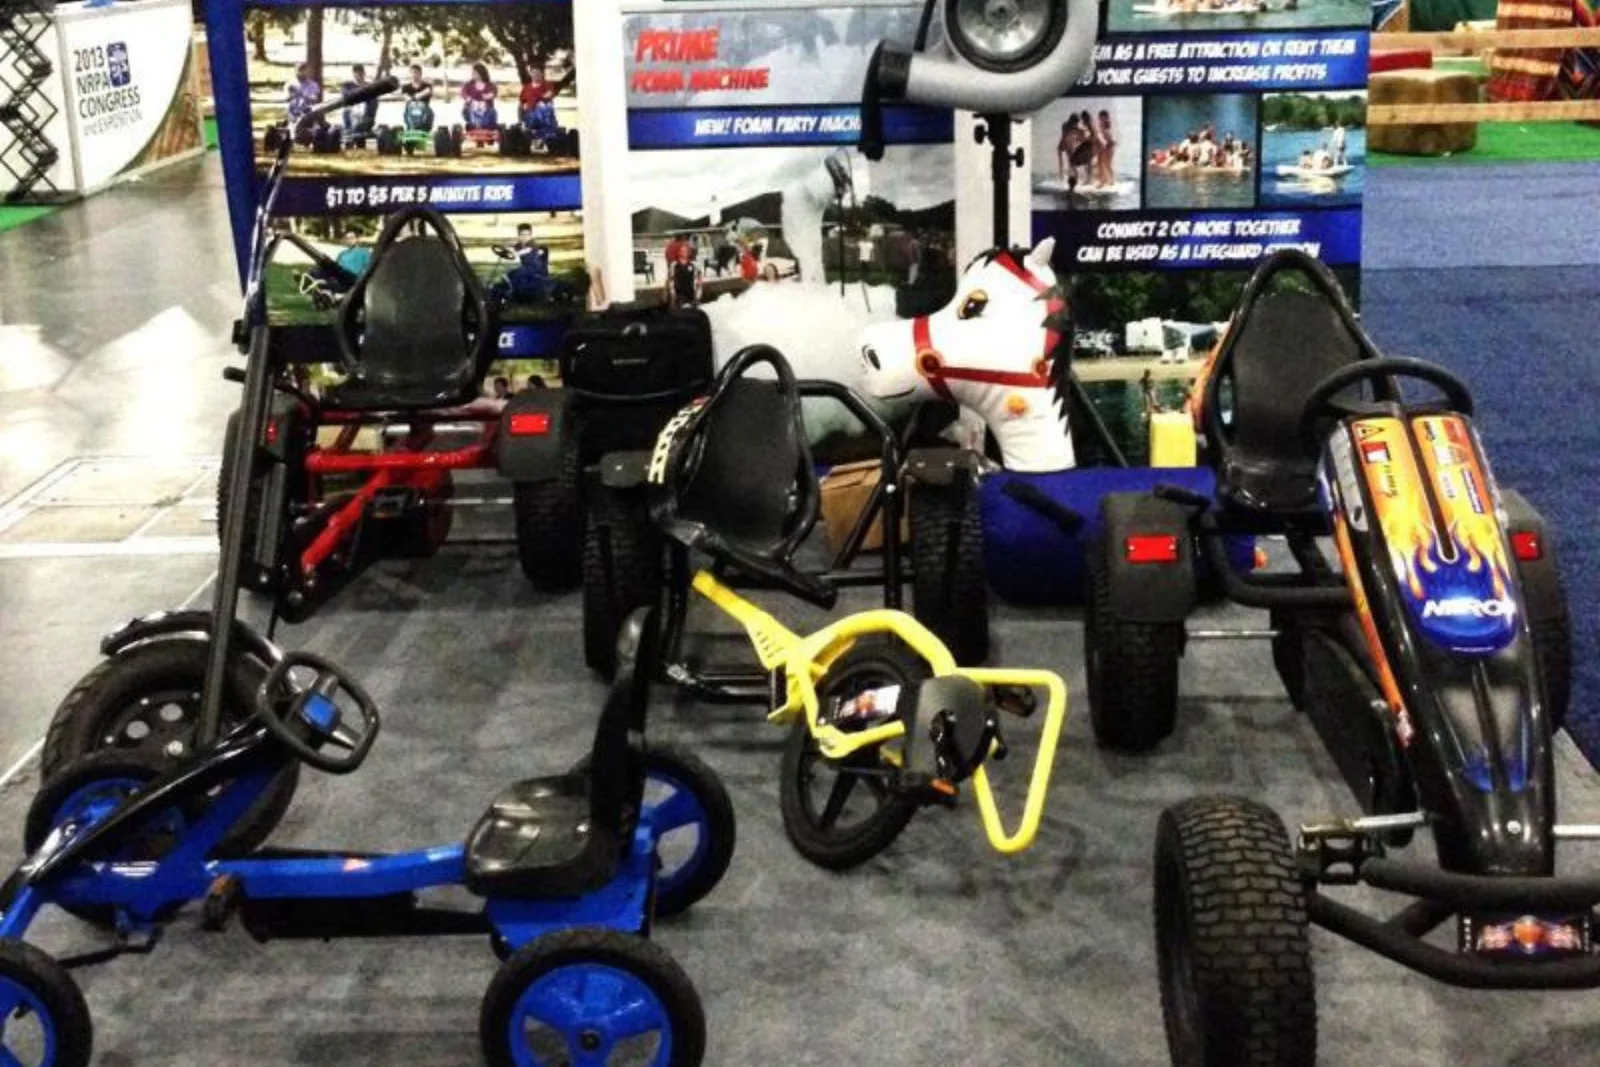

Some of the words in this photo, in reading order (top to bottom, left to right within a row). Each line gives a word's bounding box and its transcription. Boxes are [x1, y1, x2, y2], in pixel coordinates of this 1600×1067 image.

[635, 27, 718, 62] PRIME
[1114, 43, 1133, 60] AS
[1134, 43, 1146, 60] A
[1147, 42, 1178, 60] FREE
[1179, 40, 1260, 58] ATTRACTION
[1262, 39, 1283, 57] OR
[1284, 39, 1319, 56] RENT
[1320, 38, 1356, 55] THEM
[74, 45, 105, 72] 2013
[76, 71, 110, 96] NRPA
[688, 65, 770, 91] MACHINE
[1097, 67, 1133, 84] YOUR
[1133, 67, 1184, 84] GUESTS
[1186, 65, 1206, 83] TO
[1207, 63, 1273, 82] INCREASE
[1273, 62, 1327, 81] PROFITS
[79, 85, 141, 119] CONGRESS
[695, 117, 732, 136] NEW!
[733, 116, 774, 134] FOAM
[775, 115, 818, 133] PARTY
[818, 114, 862, 133] MACH
[345, 186, 366, 205] TO
[389, 185, 416, 203] PER
[417, 185, 428, 202] 5
[429, 184, 482, 203] MINUTE
[483, 183, 515, 201] RIDE
[1097, 221, 1157, 239] CONNECT
[1157, 220, 1169, 237] 2
[1170, 220, 1191, 237] OR
[1191, 220, 1232, 236] MORE
[1233, 218, 1301, 236] TOGETHER
[1077, 246, 1104, 262] CAN
[1105, 245, 1123, 261] BE
[1124, 243, 1159, 261] USED
[1159, 243, 1180, 260] AS
[1179, 243, 1191, 260] A
[1192, 242, 1262, 260] LIFEGUARD
